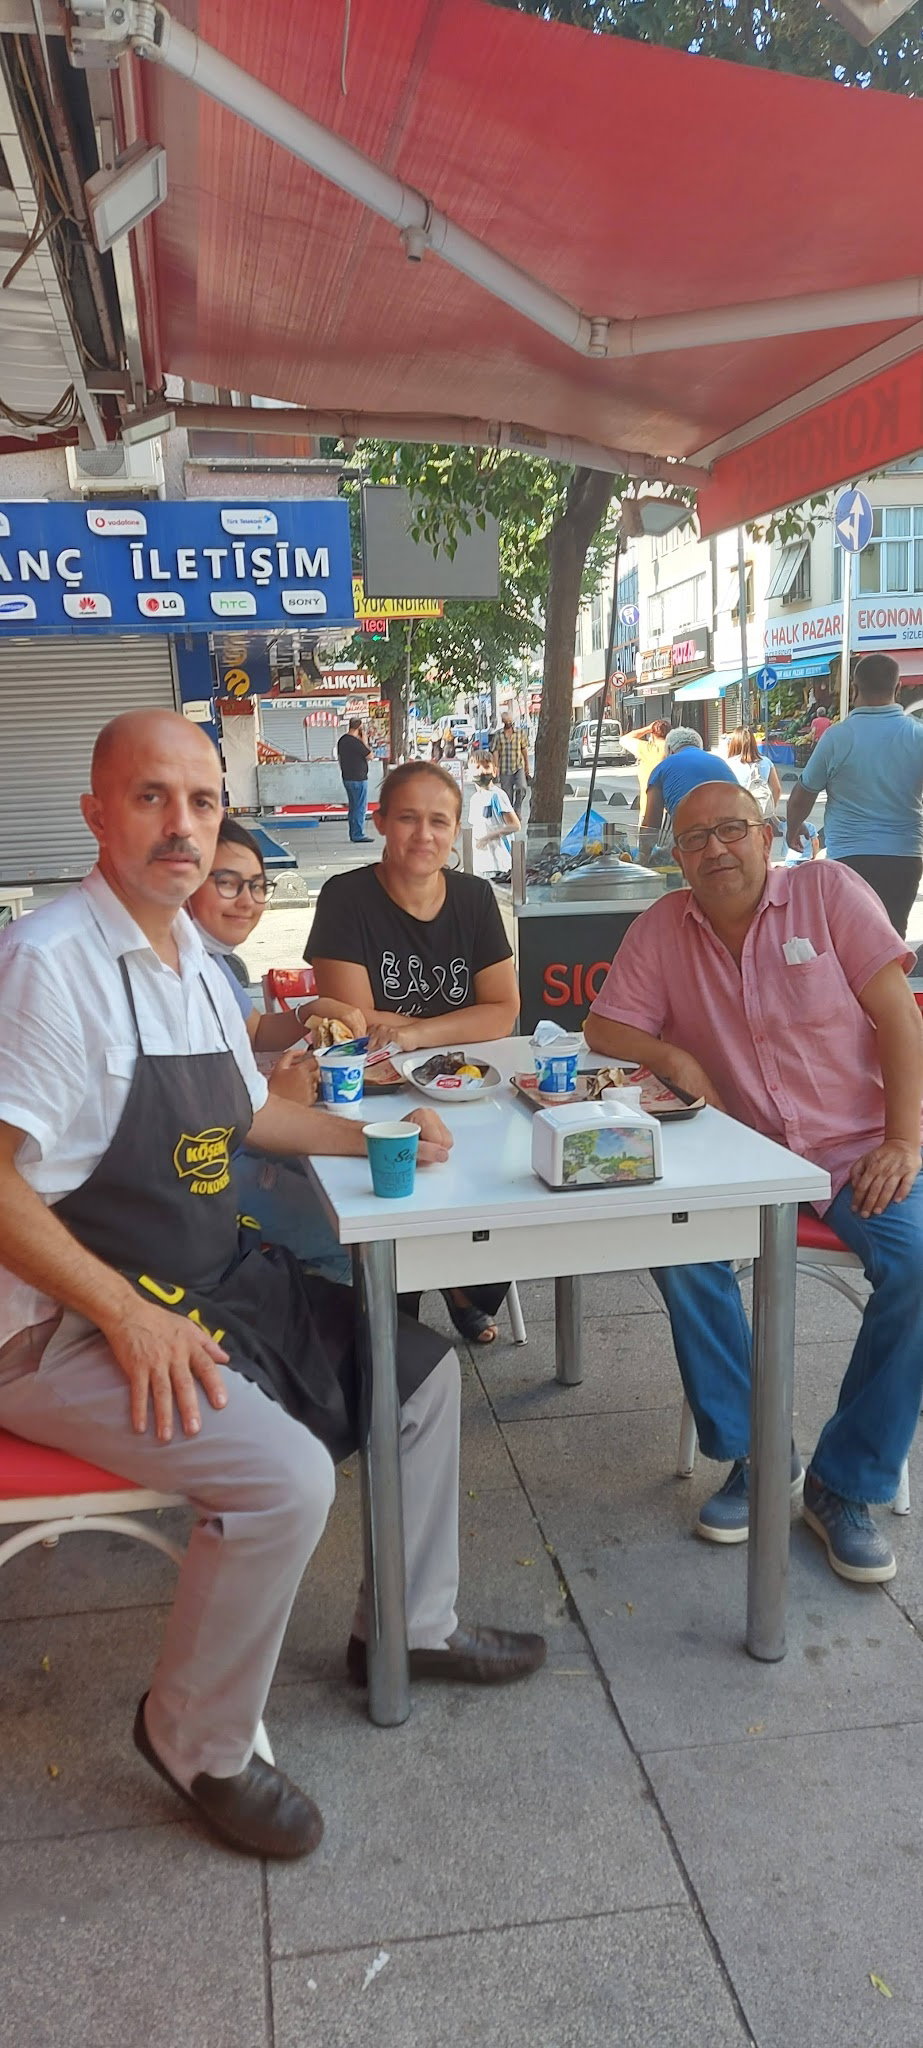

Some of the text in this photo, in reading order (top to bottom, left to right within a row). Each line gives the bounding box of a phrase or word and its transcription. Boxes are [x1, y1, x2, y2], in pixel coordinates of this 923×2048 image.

[129, 541, 330, 586] İLETİŞİM
[162, 600, 177, 608] LG
[288, 598, 320, 606] SONY
[771, 623, 800, 647] HALK
[902, 628, 923, 640] SİZLE
